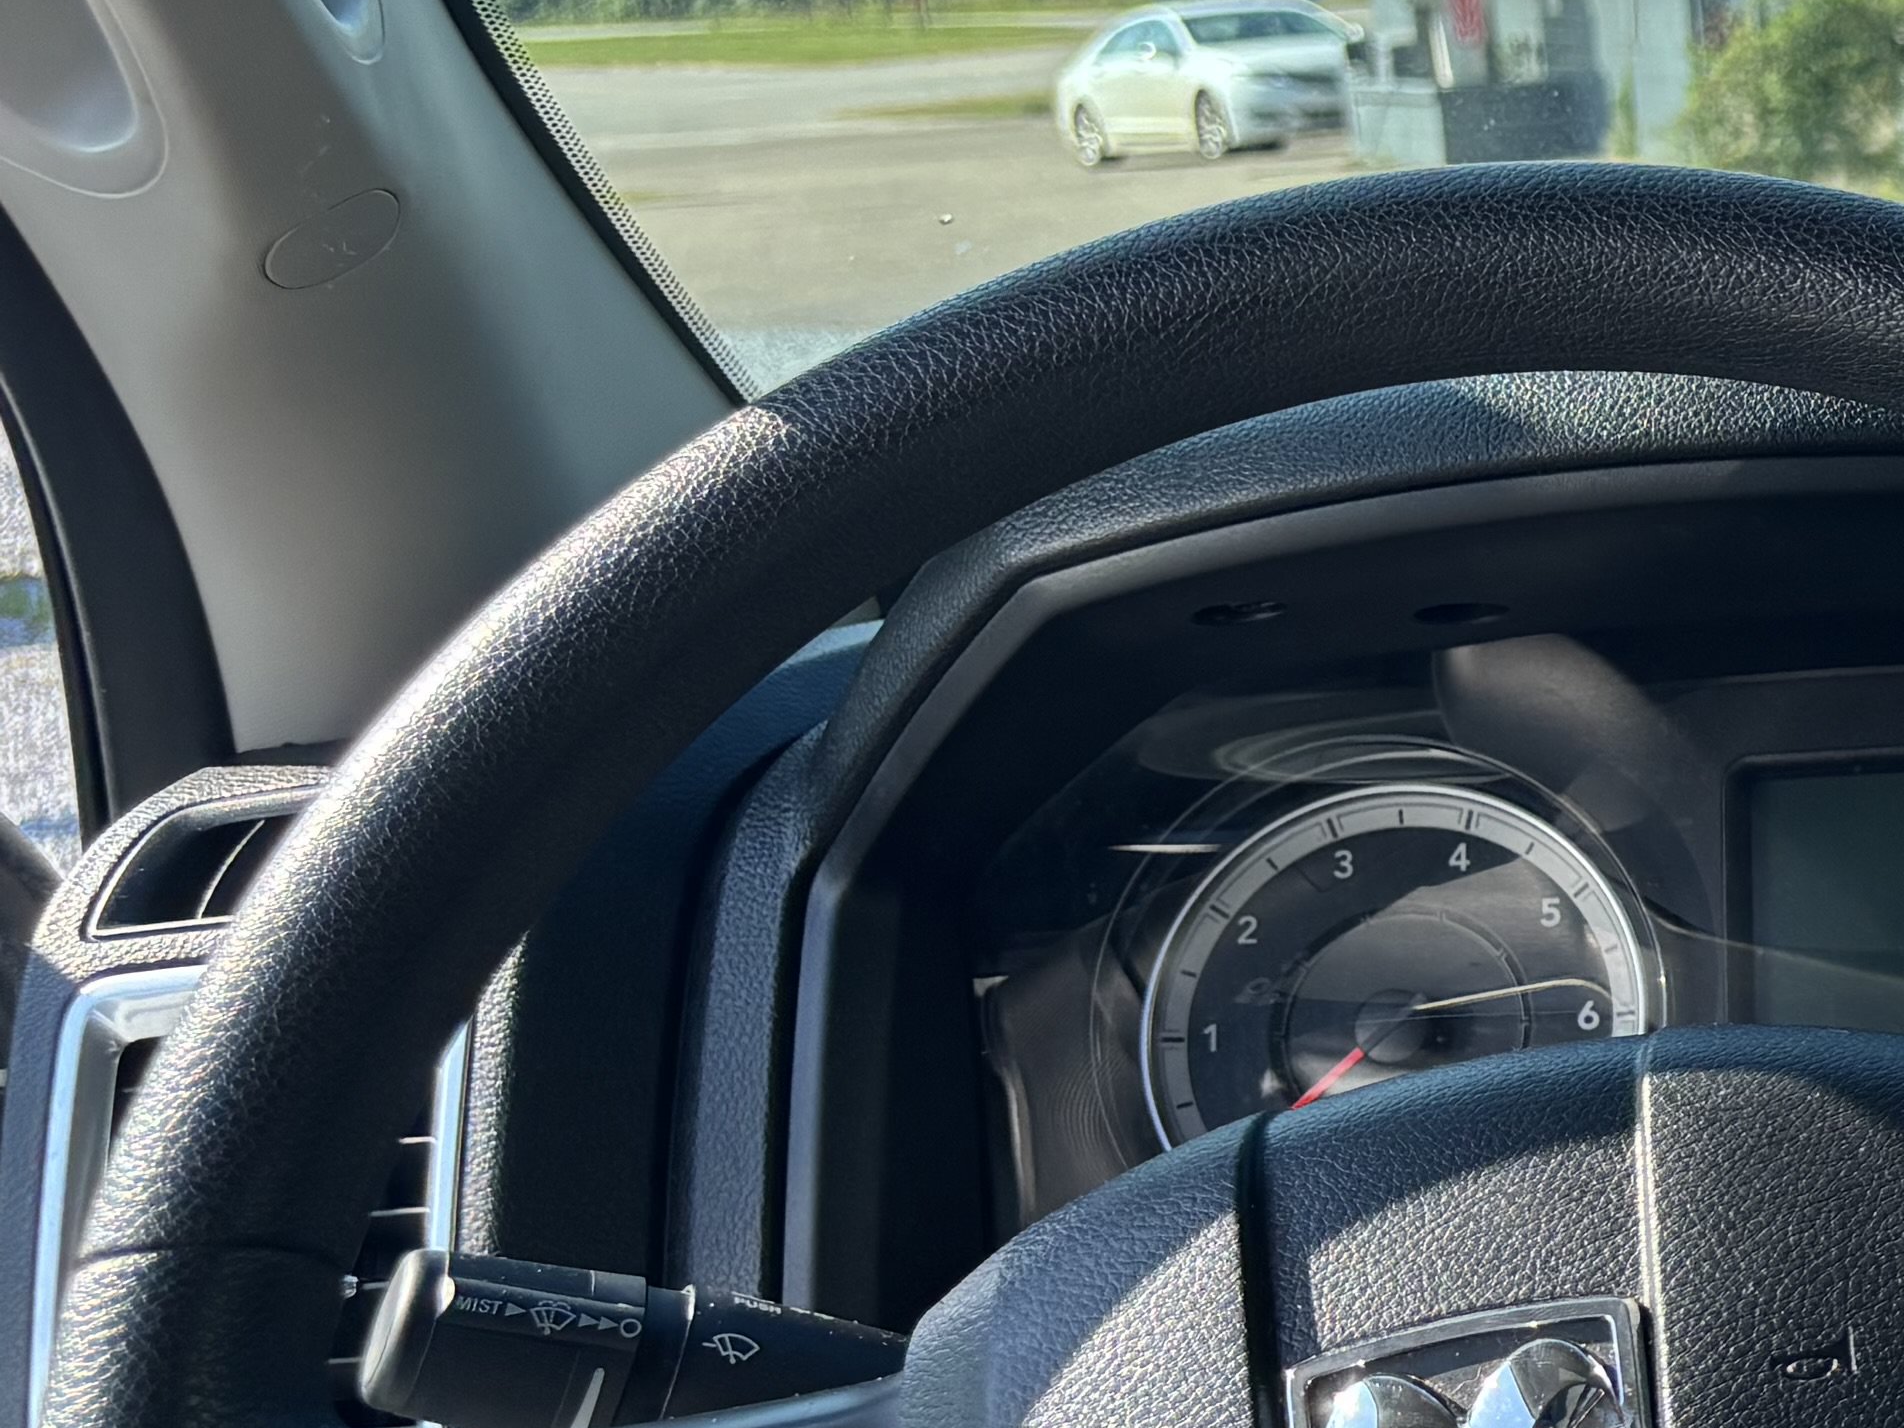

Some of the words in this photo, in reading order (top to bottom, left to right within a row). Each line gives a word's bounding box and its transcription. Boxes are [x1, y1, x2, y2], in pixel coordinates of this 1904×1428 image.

[1334, 850, 1354, 878] 3
[1449, 844, 1471, 871] 4
[1541, 899, 1561, 927] 5
[1237, 918, 1258, 944] 2
[1578, 1001, 1599, 1028] 6
[1204, 1026, 1218, 1051] 1
[455, 1296, 502, 1315] MIST
